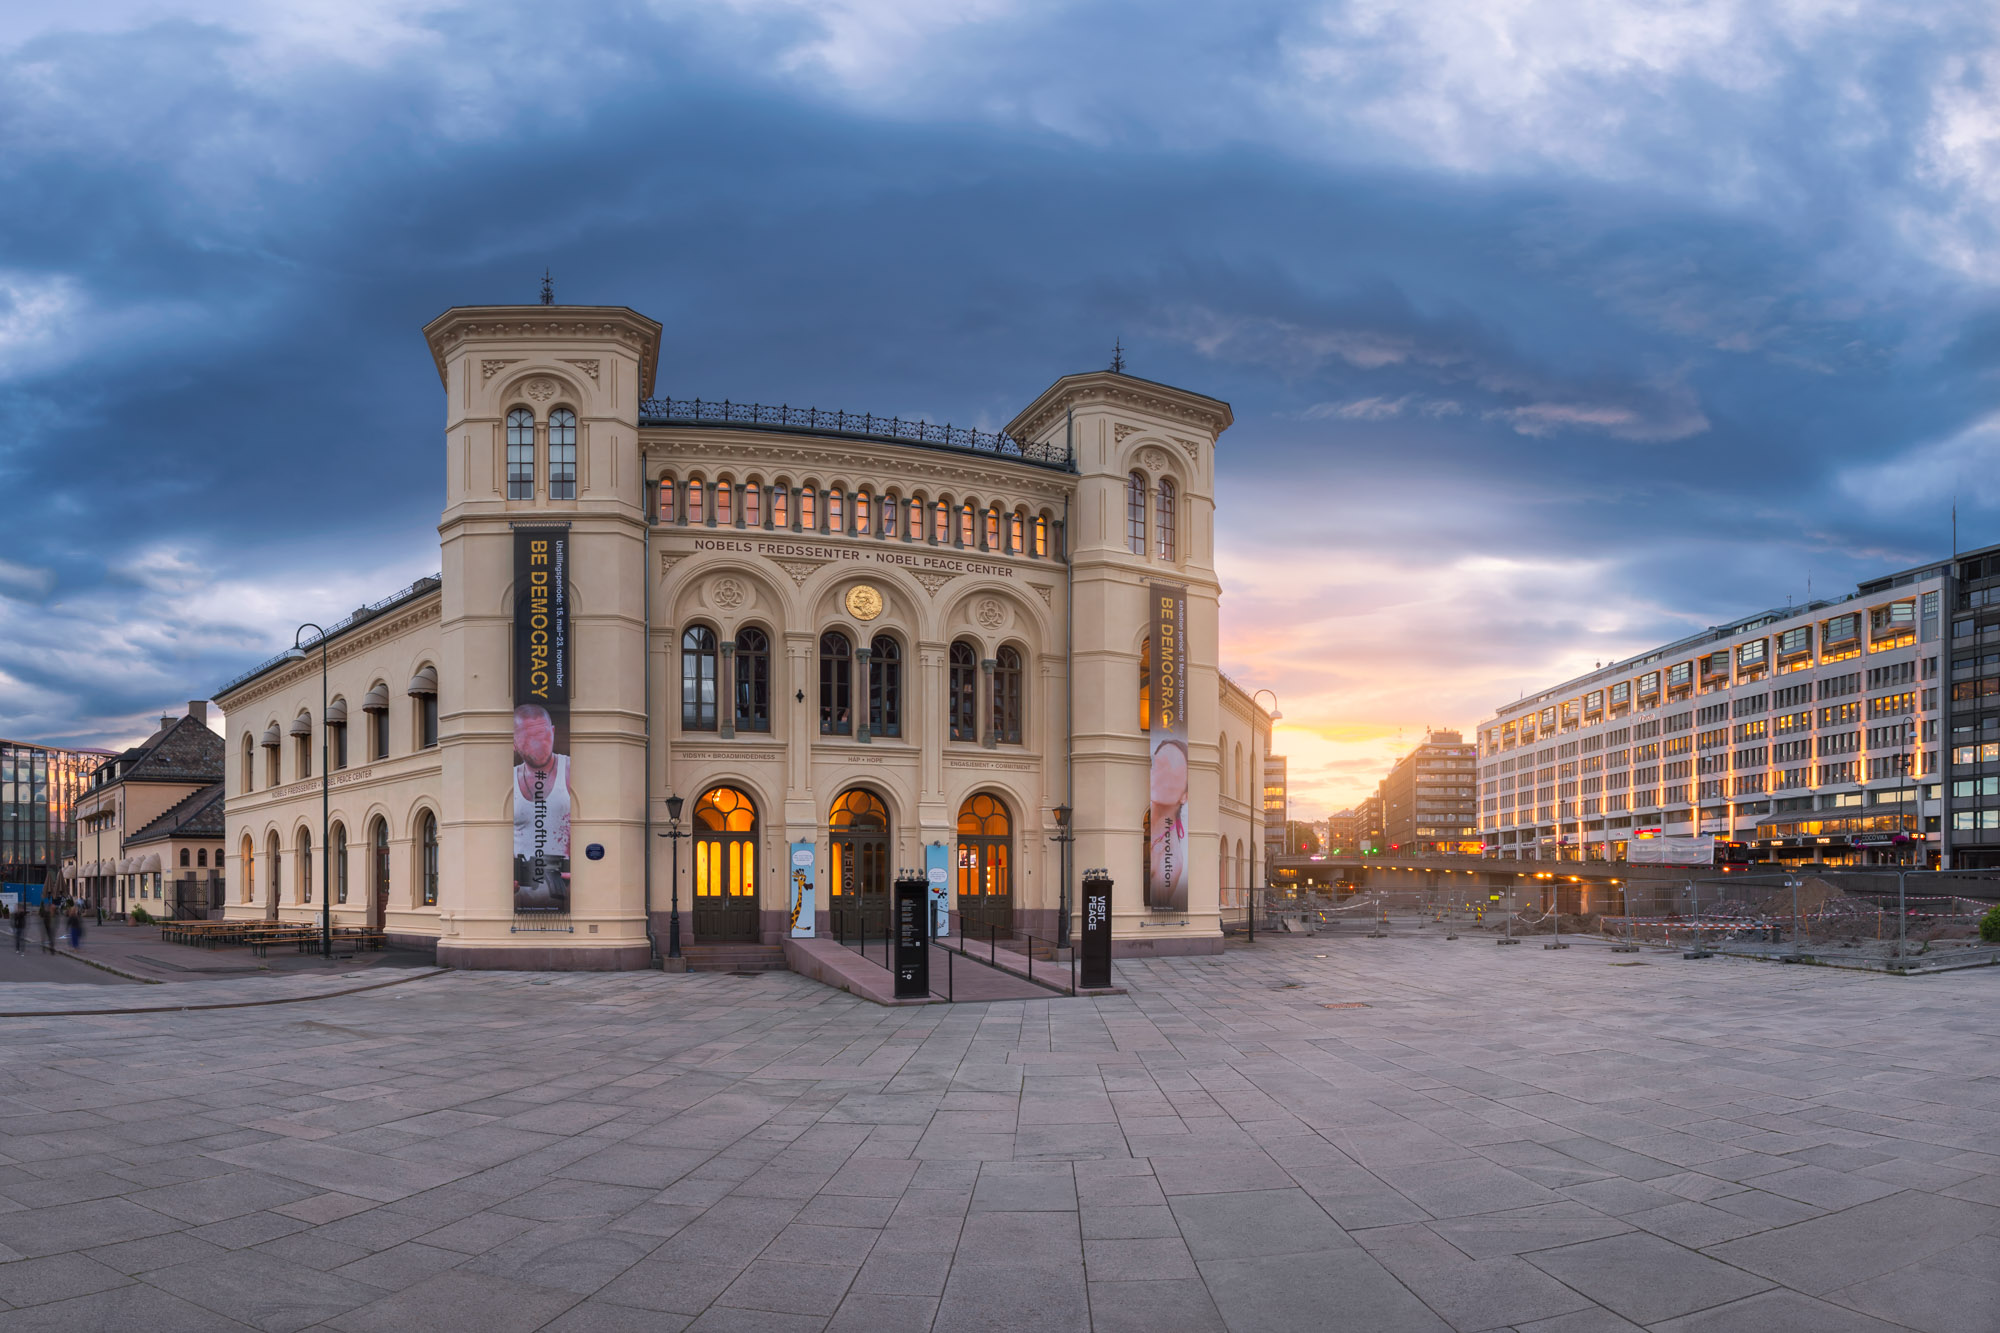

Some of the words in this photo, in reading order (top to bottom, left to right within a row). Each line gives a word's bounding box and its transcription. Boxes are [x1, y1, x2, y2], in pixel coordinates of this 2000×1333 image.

[530, 541, 548, 566] BE
[695, 540, 752, 552] NOBELS
[758, 543, 859, 560] FREDSSENTER
[876, 553, 919, 566] NOBEL
[924, 558, 963, 571] PEACE
[966, 563, 1013, 577] CENTER
[555, 540, 564, 605] Utstillingsperiode:
[556, 607, 564, 617] 15.
[1161, 597, 1174, 619] BE
[530, 572, 549, 699] DEMOCRACY
[556, 649, 564, 688] november
[1161, 623, 1174, 733] DEMOCRACY
[271, 790, 288, 799] NOBELS
[336, 773, 352, 784] PEACE
[353, 770, 372, 781] CENTER
[533, 770, 547, 885] #outfitoftheday
[1164, 817, 1173, 888] #revolution
[1088, 895, 1097, 931] PEACE
[1098, 895, 1106, 921] VISIT
